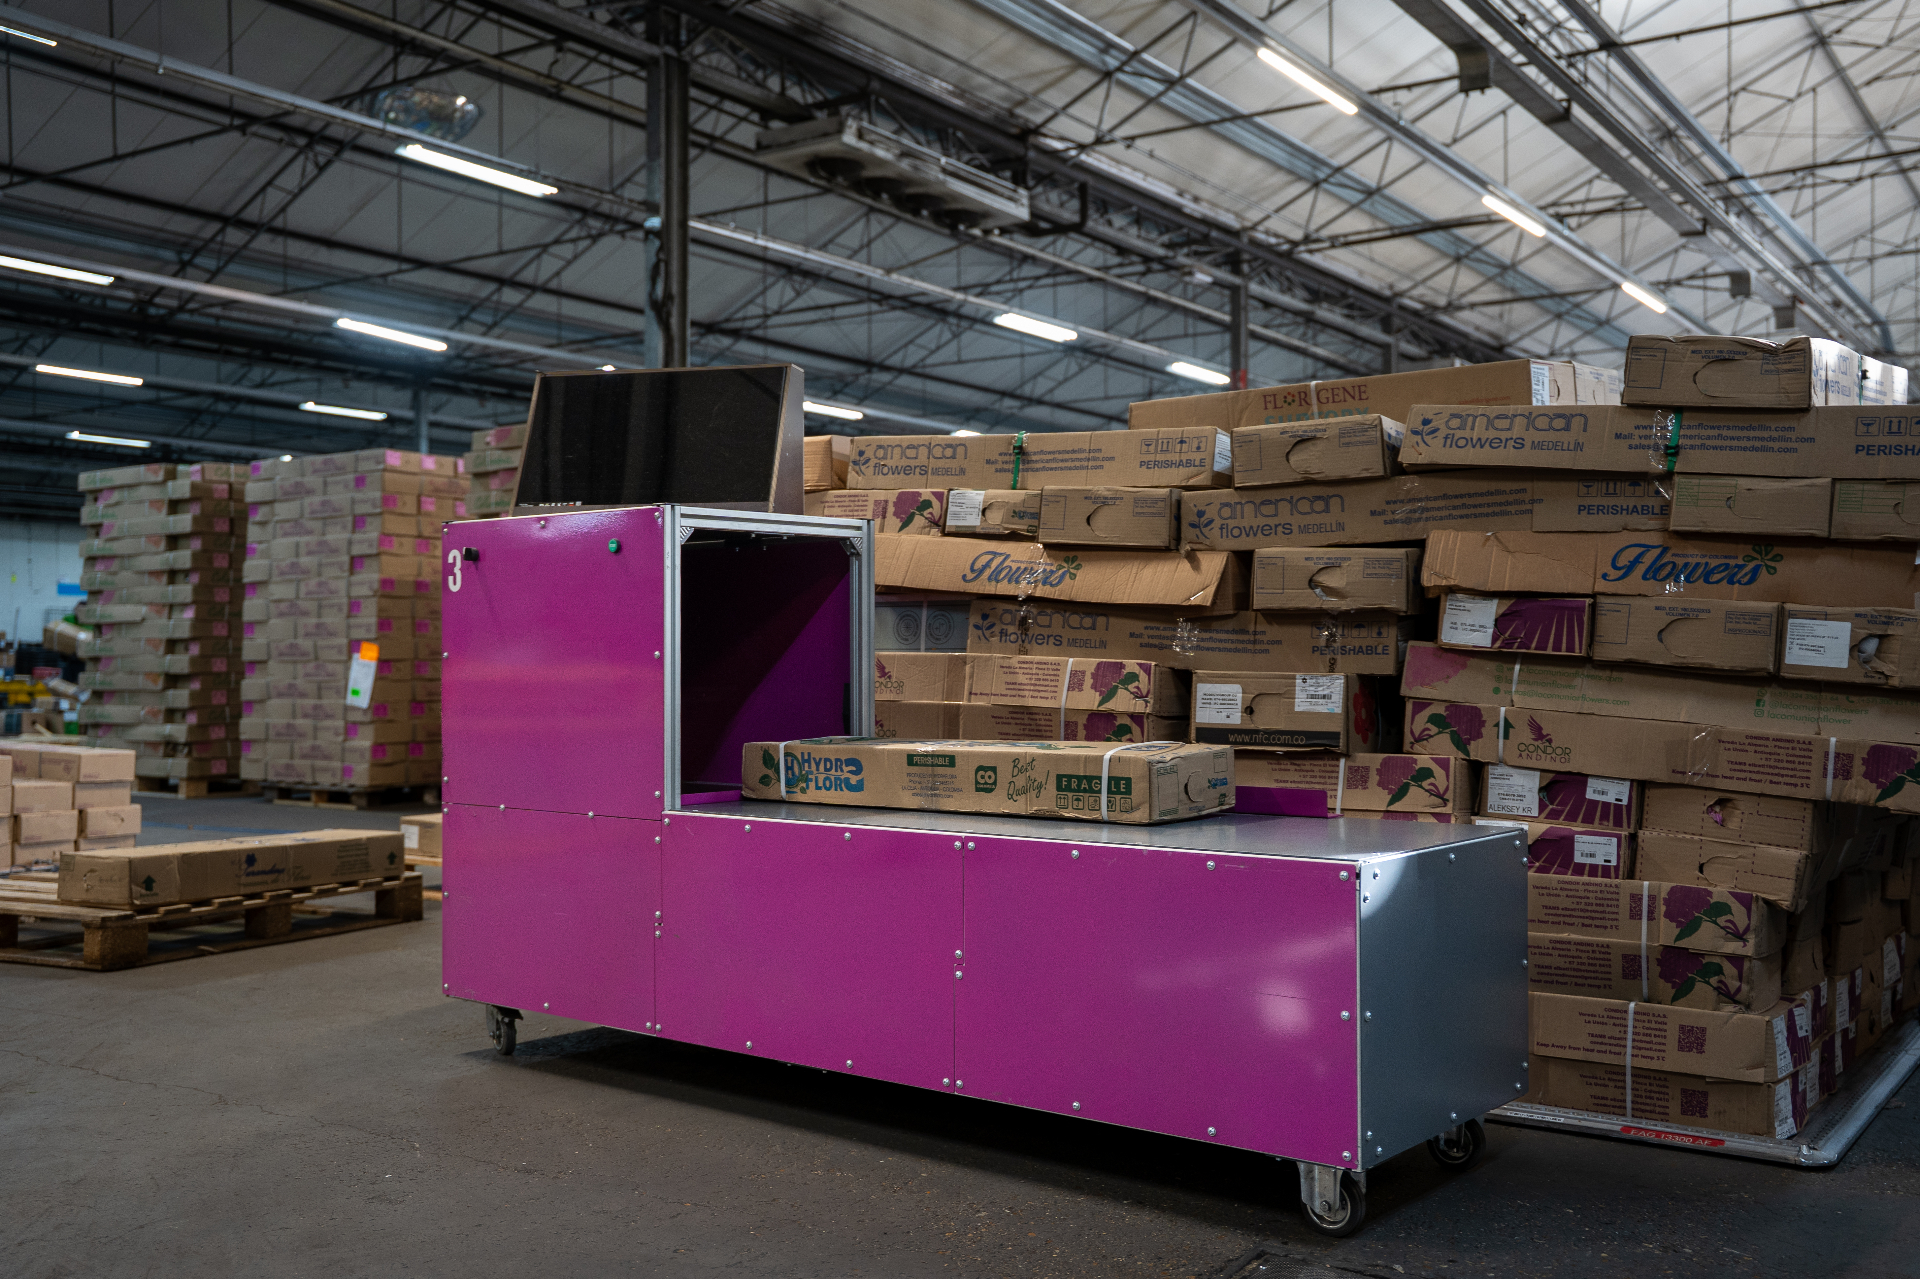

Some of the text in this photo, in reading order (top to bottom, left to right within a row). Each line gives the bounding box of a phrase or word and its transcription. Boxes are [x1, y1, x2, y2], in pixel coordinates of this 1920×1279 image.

[1444, 411, 1588, 433] american
[1442, 432, 1584, 452] flowers MEDELLÍN
[874, 442, 967, 460] american
[873, 461, 966, 476] flowers MEDELLÍN
[1139, 457, 1207, 470] PERISHABLE
[1217, 494, 1345, 521] american
[1577, 504, 1669, 516] PERISHABLE
[1218, 519, 1345, 539] flowers MEDELLÍN
[447, 548, 462, 593] 3
[962, 550, 1070, 588] Flowers
[1602, 542, 1764, 586] Flowers
[999, 608, 1109, 632] american
[999, 628, 1107, 650] flowers MEDELLÍN
[1311, 644, 1390, 657] PERISHABLE
[1228, 731, 1306, 745] www.nfc.com.co
[1517, 742, 1572, 758] CONDOR
[913, 756, 950, 765] PERISHABLE
[1517, 752, 1567, 764] ANDINO
[976, 769, 996, 784] CO
[1061, 777, 1127, 793] FRAGLE
[1488, 803, 1533, 815] ALEKSEY KR
[1603, 1007, 1628, 1015] CONDOR
[1536, 1041, 1550, 1049] Keep
[1551, 1043, 1567, 1051] Away
[1604, 1069, 1627, 1077] CONDO
[1660, 1133, 1693, 1145] 13300
